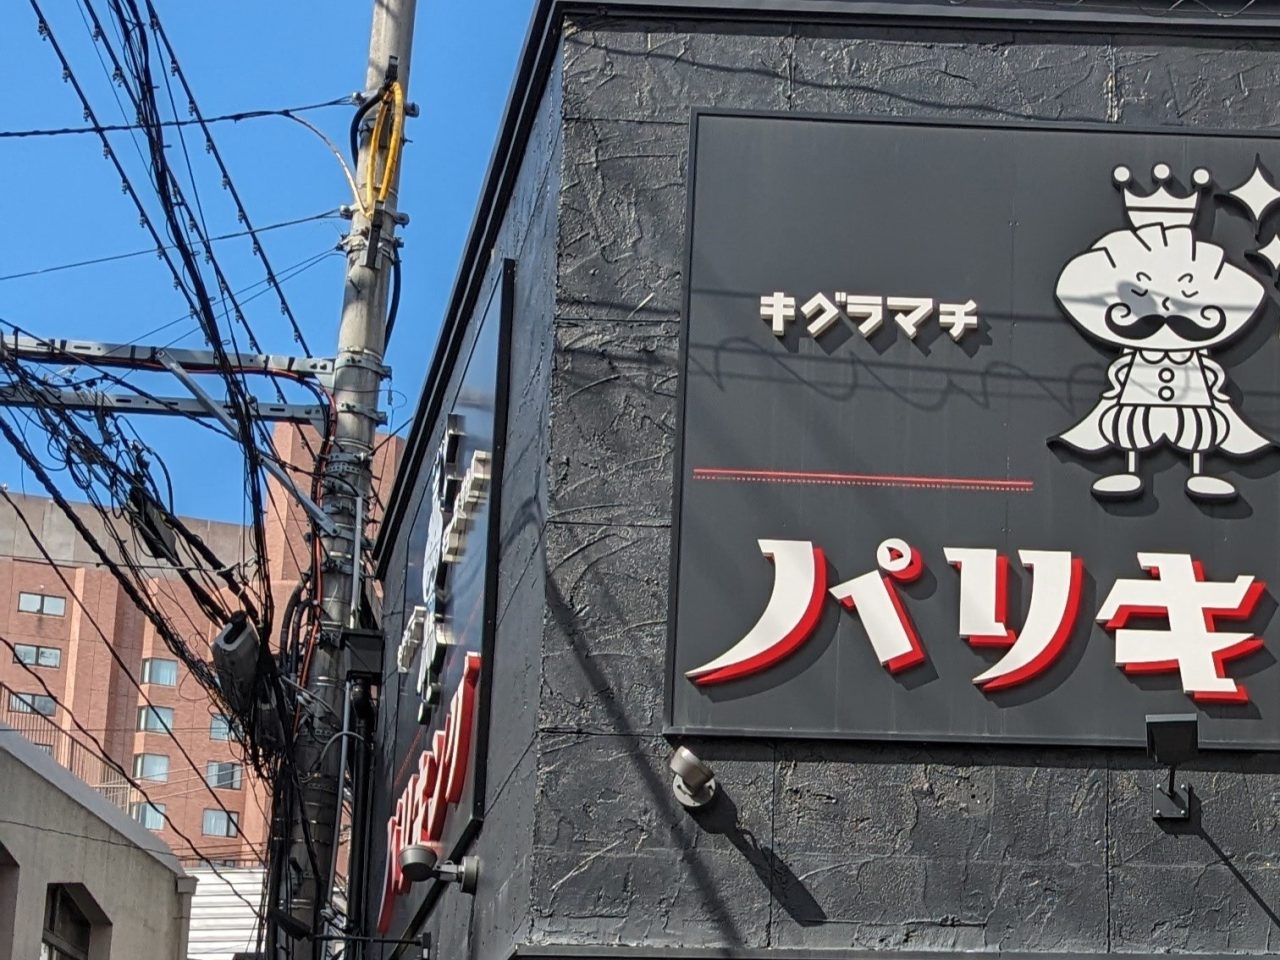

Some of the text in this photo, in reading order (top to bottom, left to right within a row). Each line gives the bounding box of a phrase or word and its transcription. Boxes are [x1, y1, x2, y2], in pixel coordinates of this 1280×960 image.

[758, 290, 979, 341] キグラマチ
